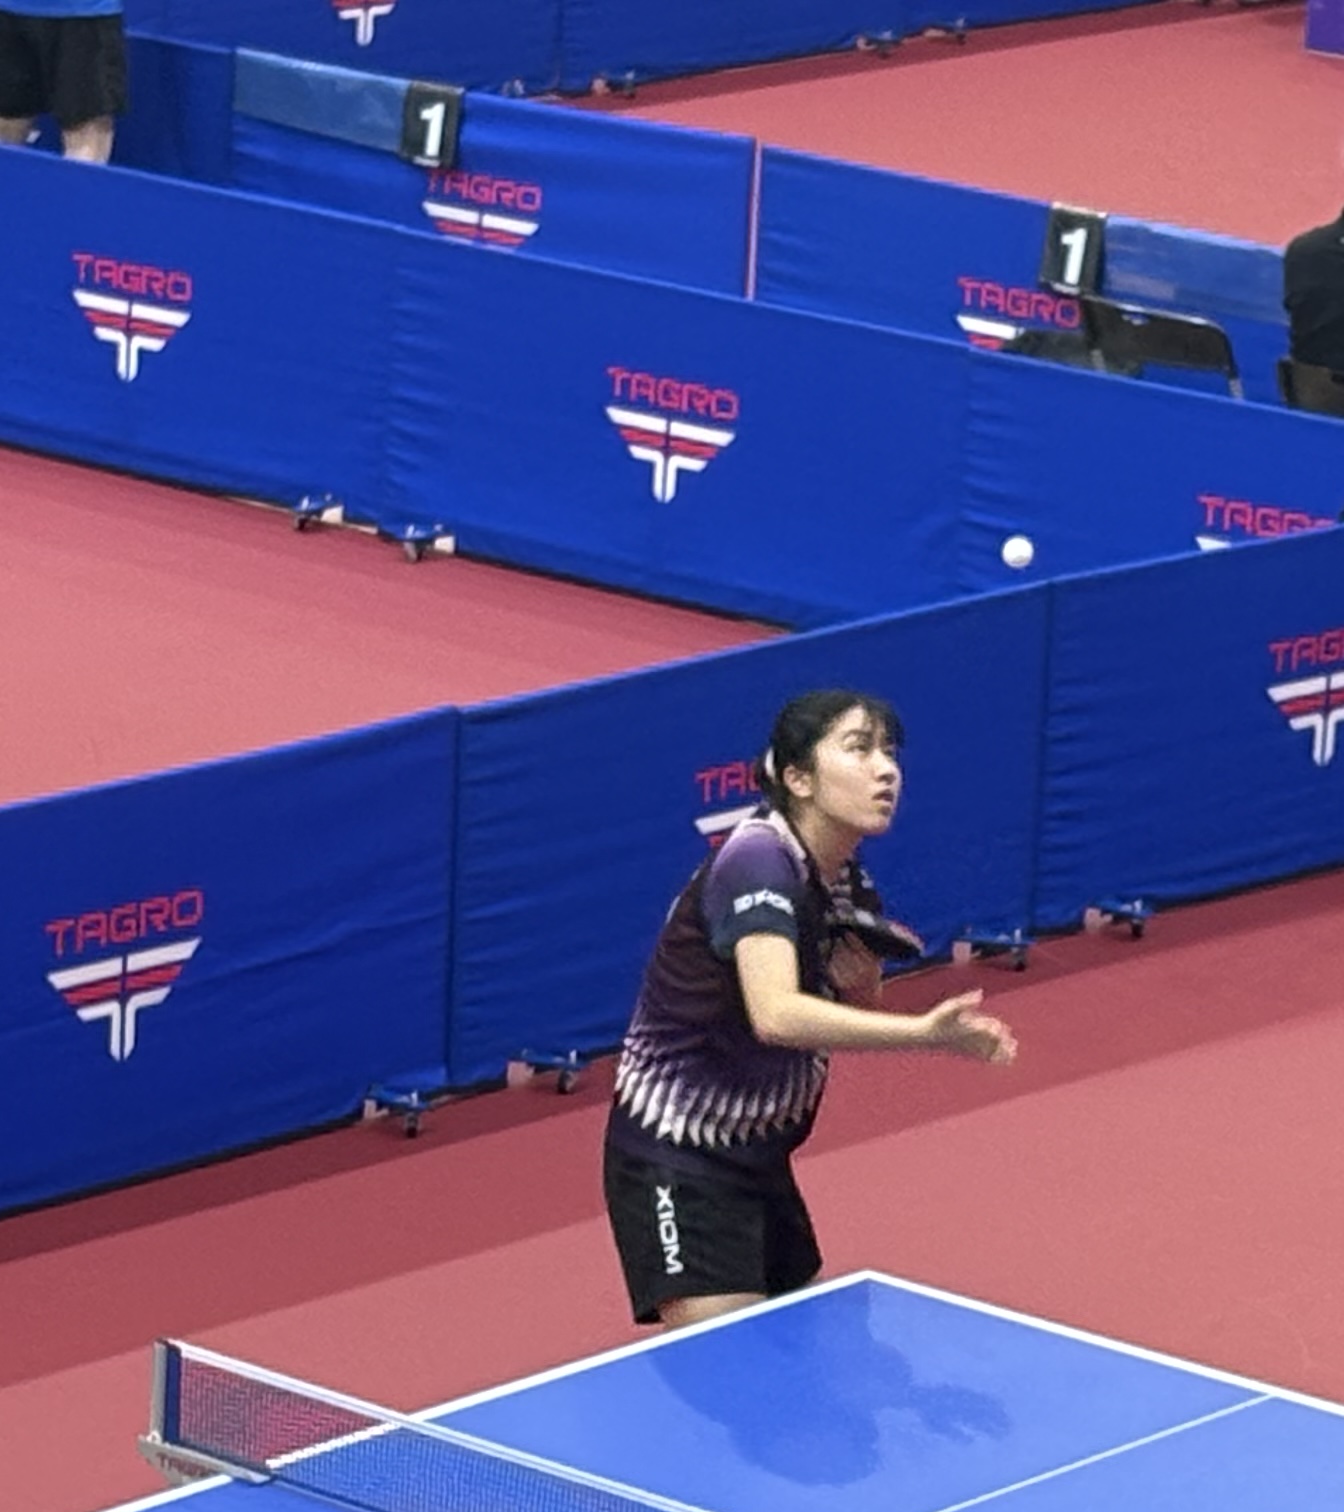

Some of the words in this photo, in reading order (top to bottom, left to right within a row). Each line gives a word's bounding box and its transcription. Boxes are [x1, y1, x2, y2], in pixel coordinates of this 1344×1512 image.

[419, 102, 446, 162] 1
[72, 253, 192, 301] TAGRO
[1061, 227, 1087, 285] 1
[956, 276, 1082, 328] TAGRO
[607, 366, 739, 420] TAGRO
[44, 889, 205, 957] TAGRO
[656, 1184, 684, 1275] XIOM
